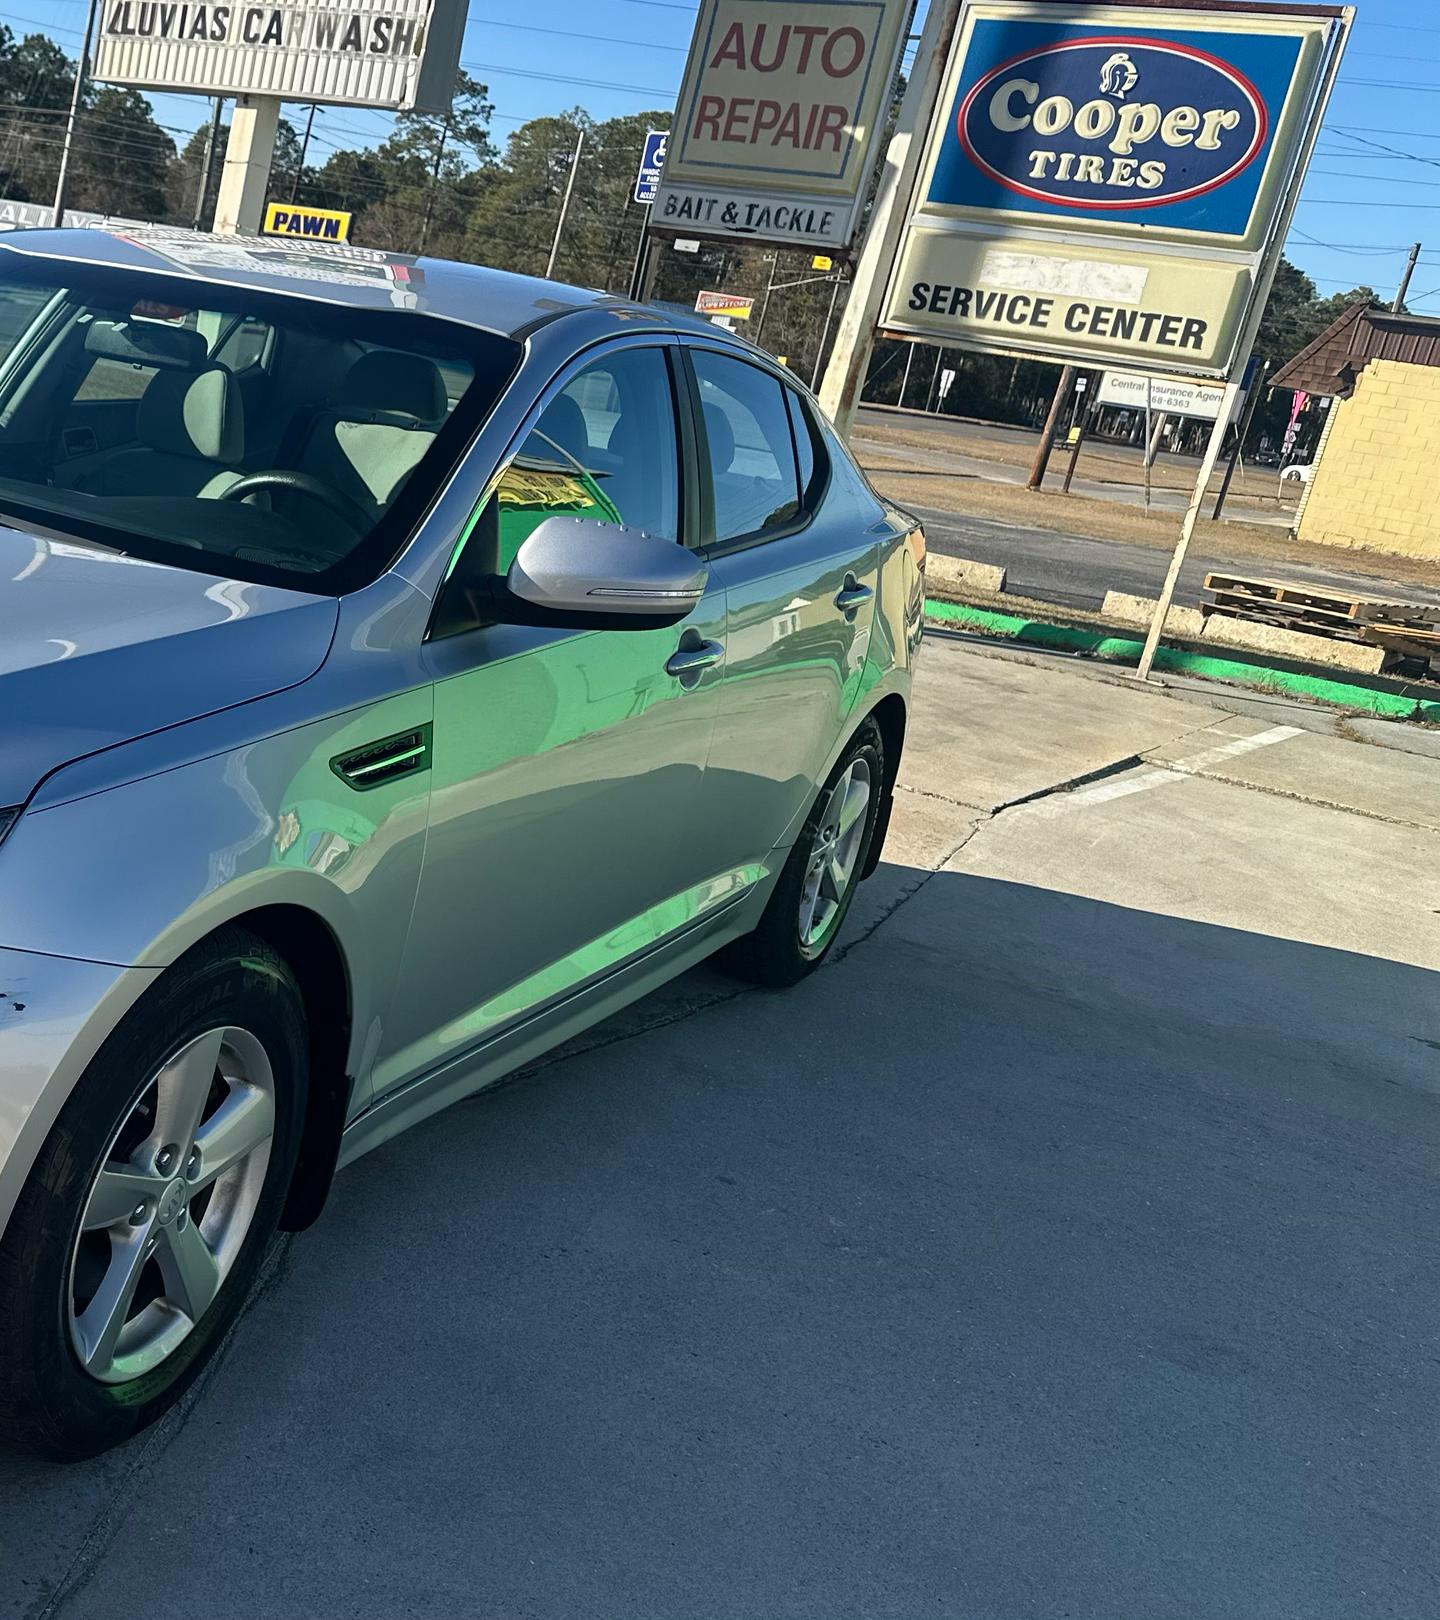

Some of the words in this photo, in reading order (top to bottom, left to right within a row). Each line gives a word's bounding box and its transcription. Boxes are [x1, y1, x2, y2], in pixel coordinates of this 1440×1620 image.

[316, 14, 415, 55] WASH
[709, 22, 866, 78] AUTO
[693, 95, 849, 152] REPAIR
[989, 78, 1241, 155] Cooper
[1028, 150, 1166, 189] TIRES
[272, 211, 341, 239] PAWN
[664, 194, 718, 222] BAIT
[720, 201, 740, 224] &
[743, 203, 835, 236] TACKLE
[909, 282, 1055, 328] SERVICE
[1064, 303, 1208, 350] CENTER
[1111, 378, 1145, 391] Central
[1146, 395, 1191, 408] 68-6363
